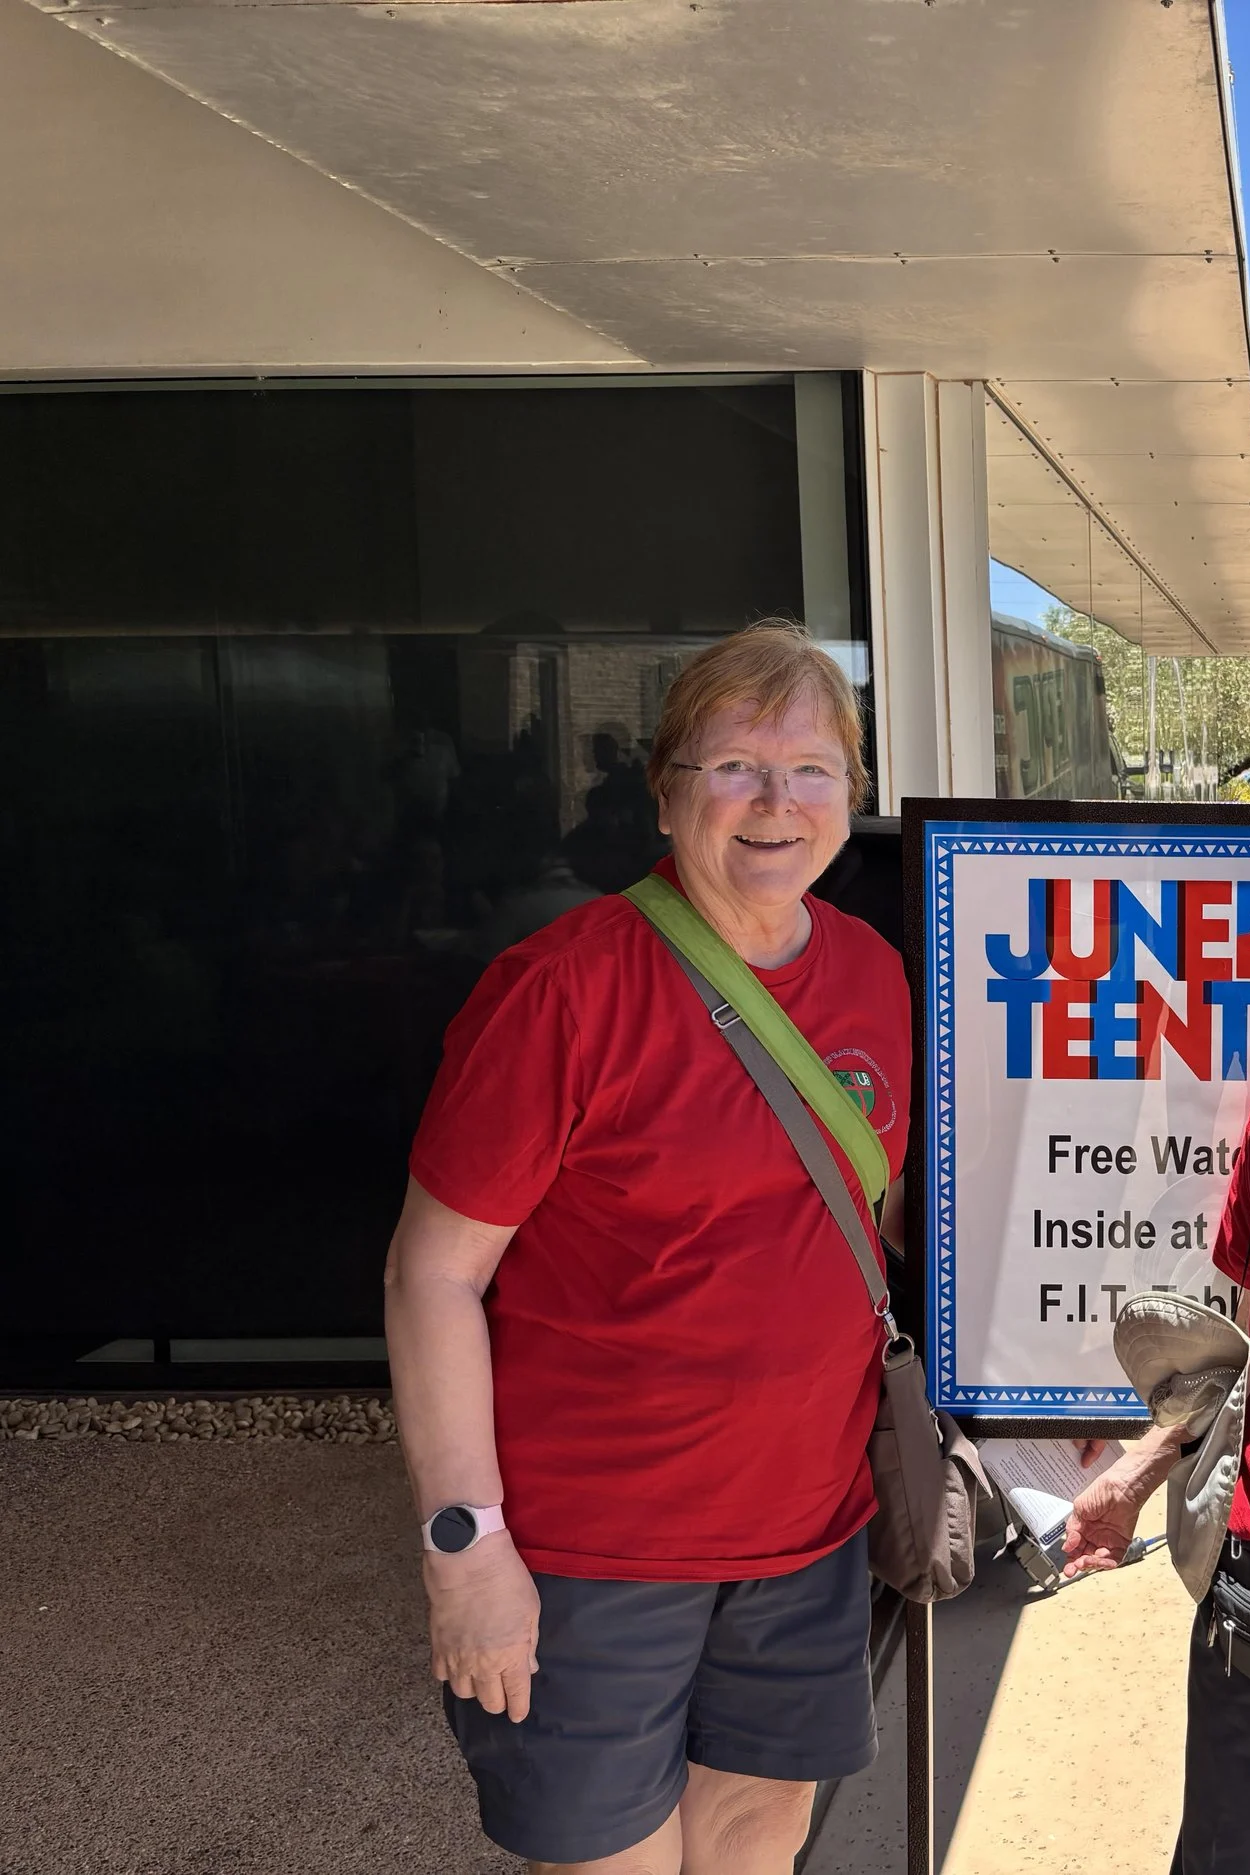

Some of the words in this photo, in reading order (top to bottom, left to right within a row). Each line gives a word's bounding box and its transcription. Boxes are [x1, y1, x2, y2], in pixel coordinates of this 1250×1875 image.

[1049, 1135, 1137, 1174] Free
[1034, 1209, 1156, 1249] Inside
[1171, 1212, 1207, 1249] at
